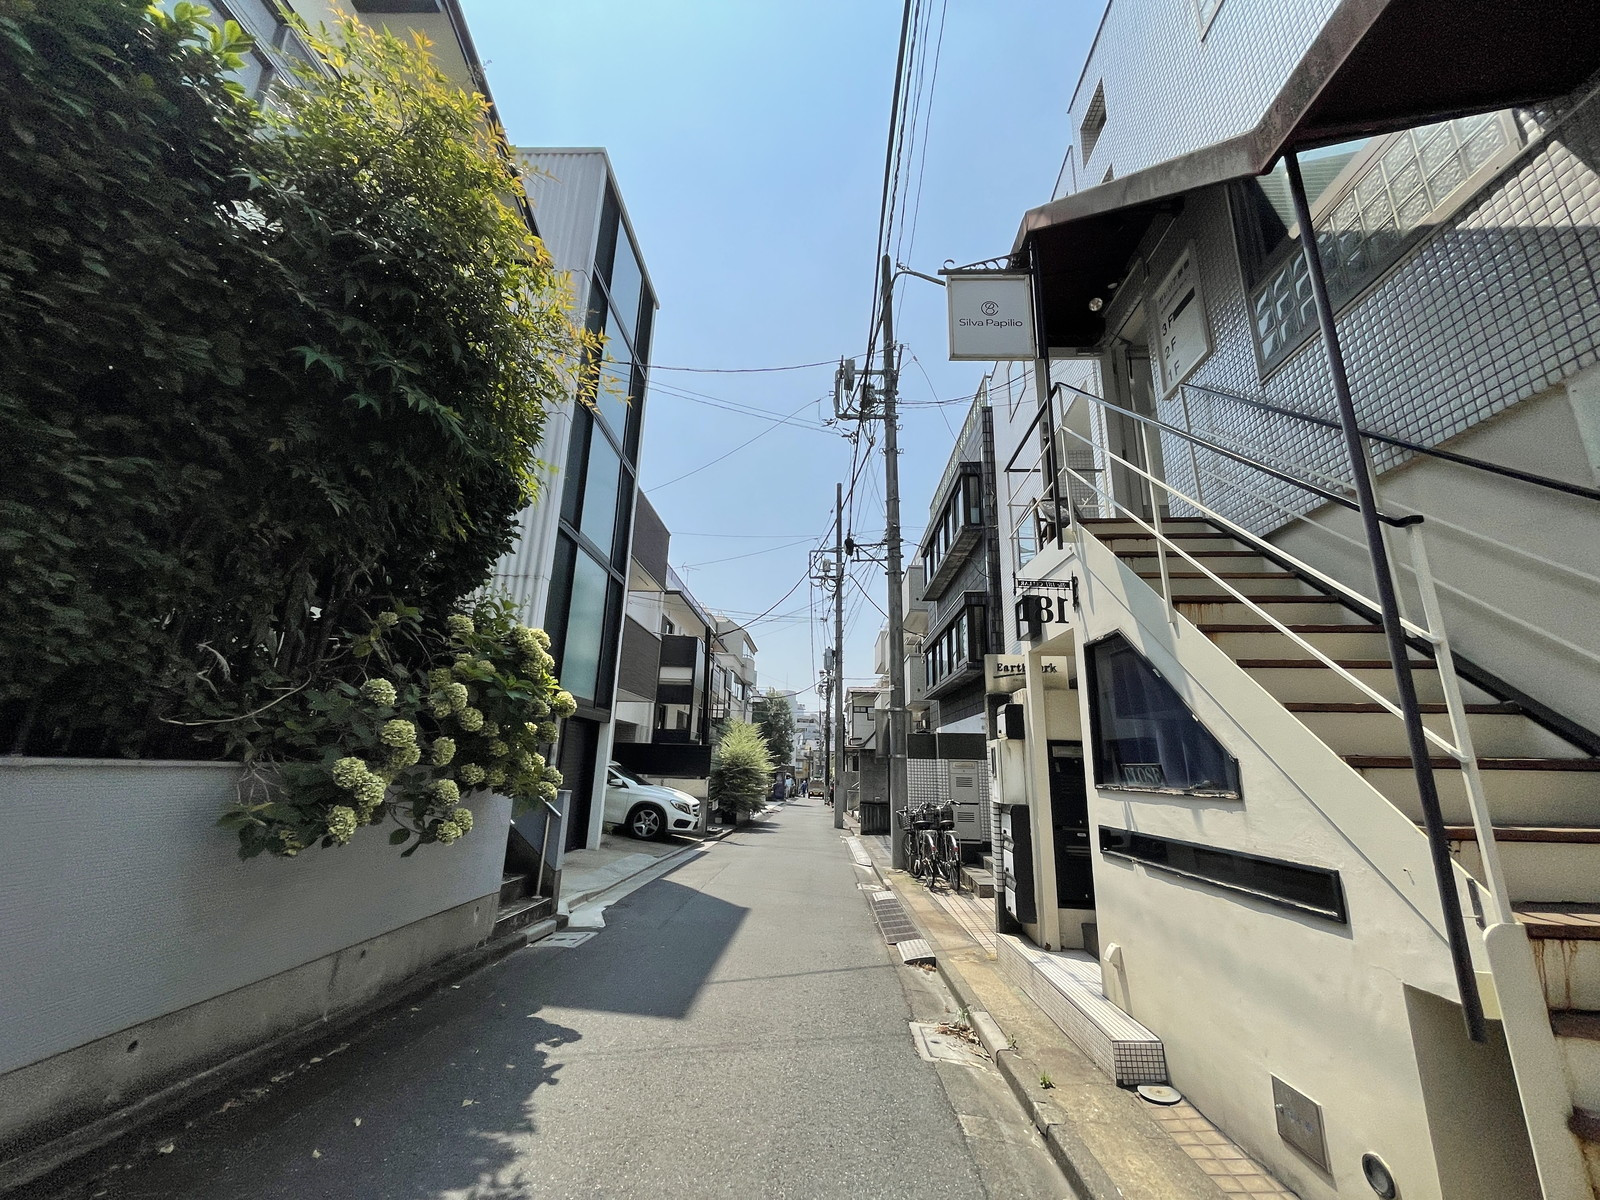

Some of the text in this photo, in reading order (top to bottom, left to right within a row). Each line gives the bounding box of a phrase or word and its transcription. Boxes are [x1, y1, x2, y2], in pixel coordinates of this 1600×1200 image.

[959, 318, 1023, 328] Silva Papilio
[1124, 766, 1162, 784] CLOSE
